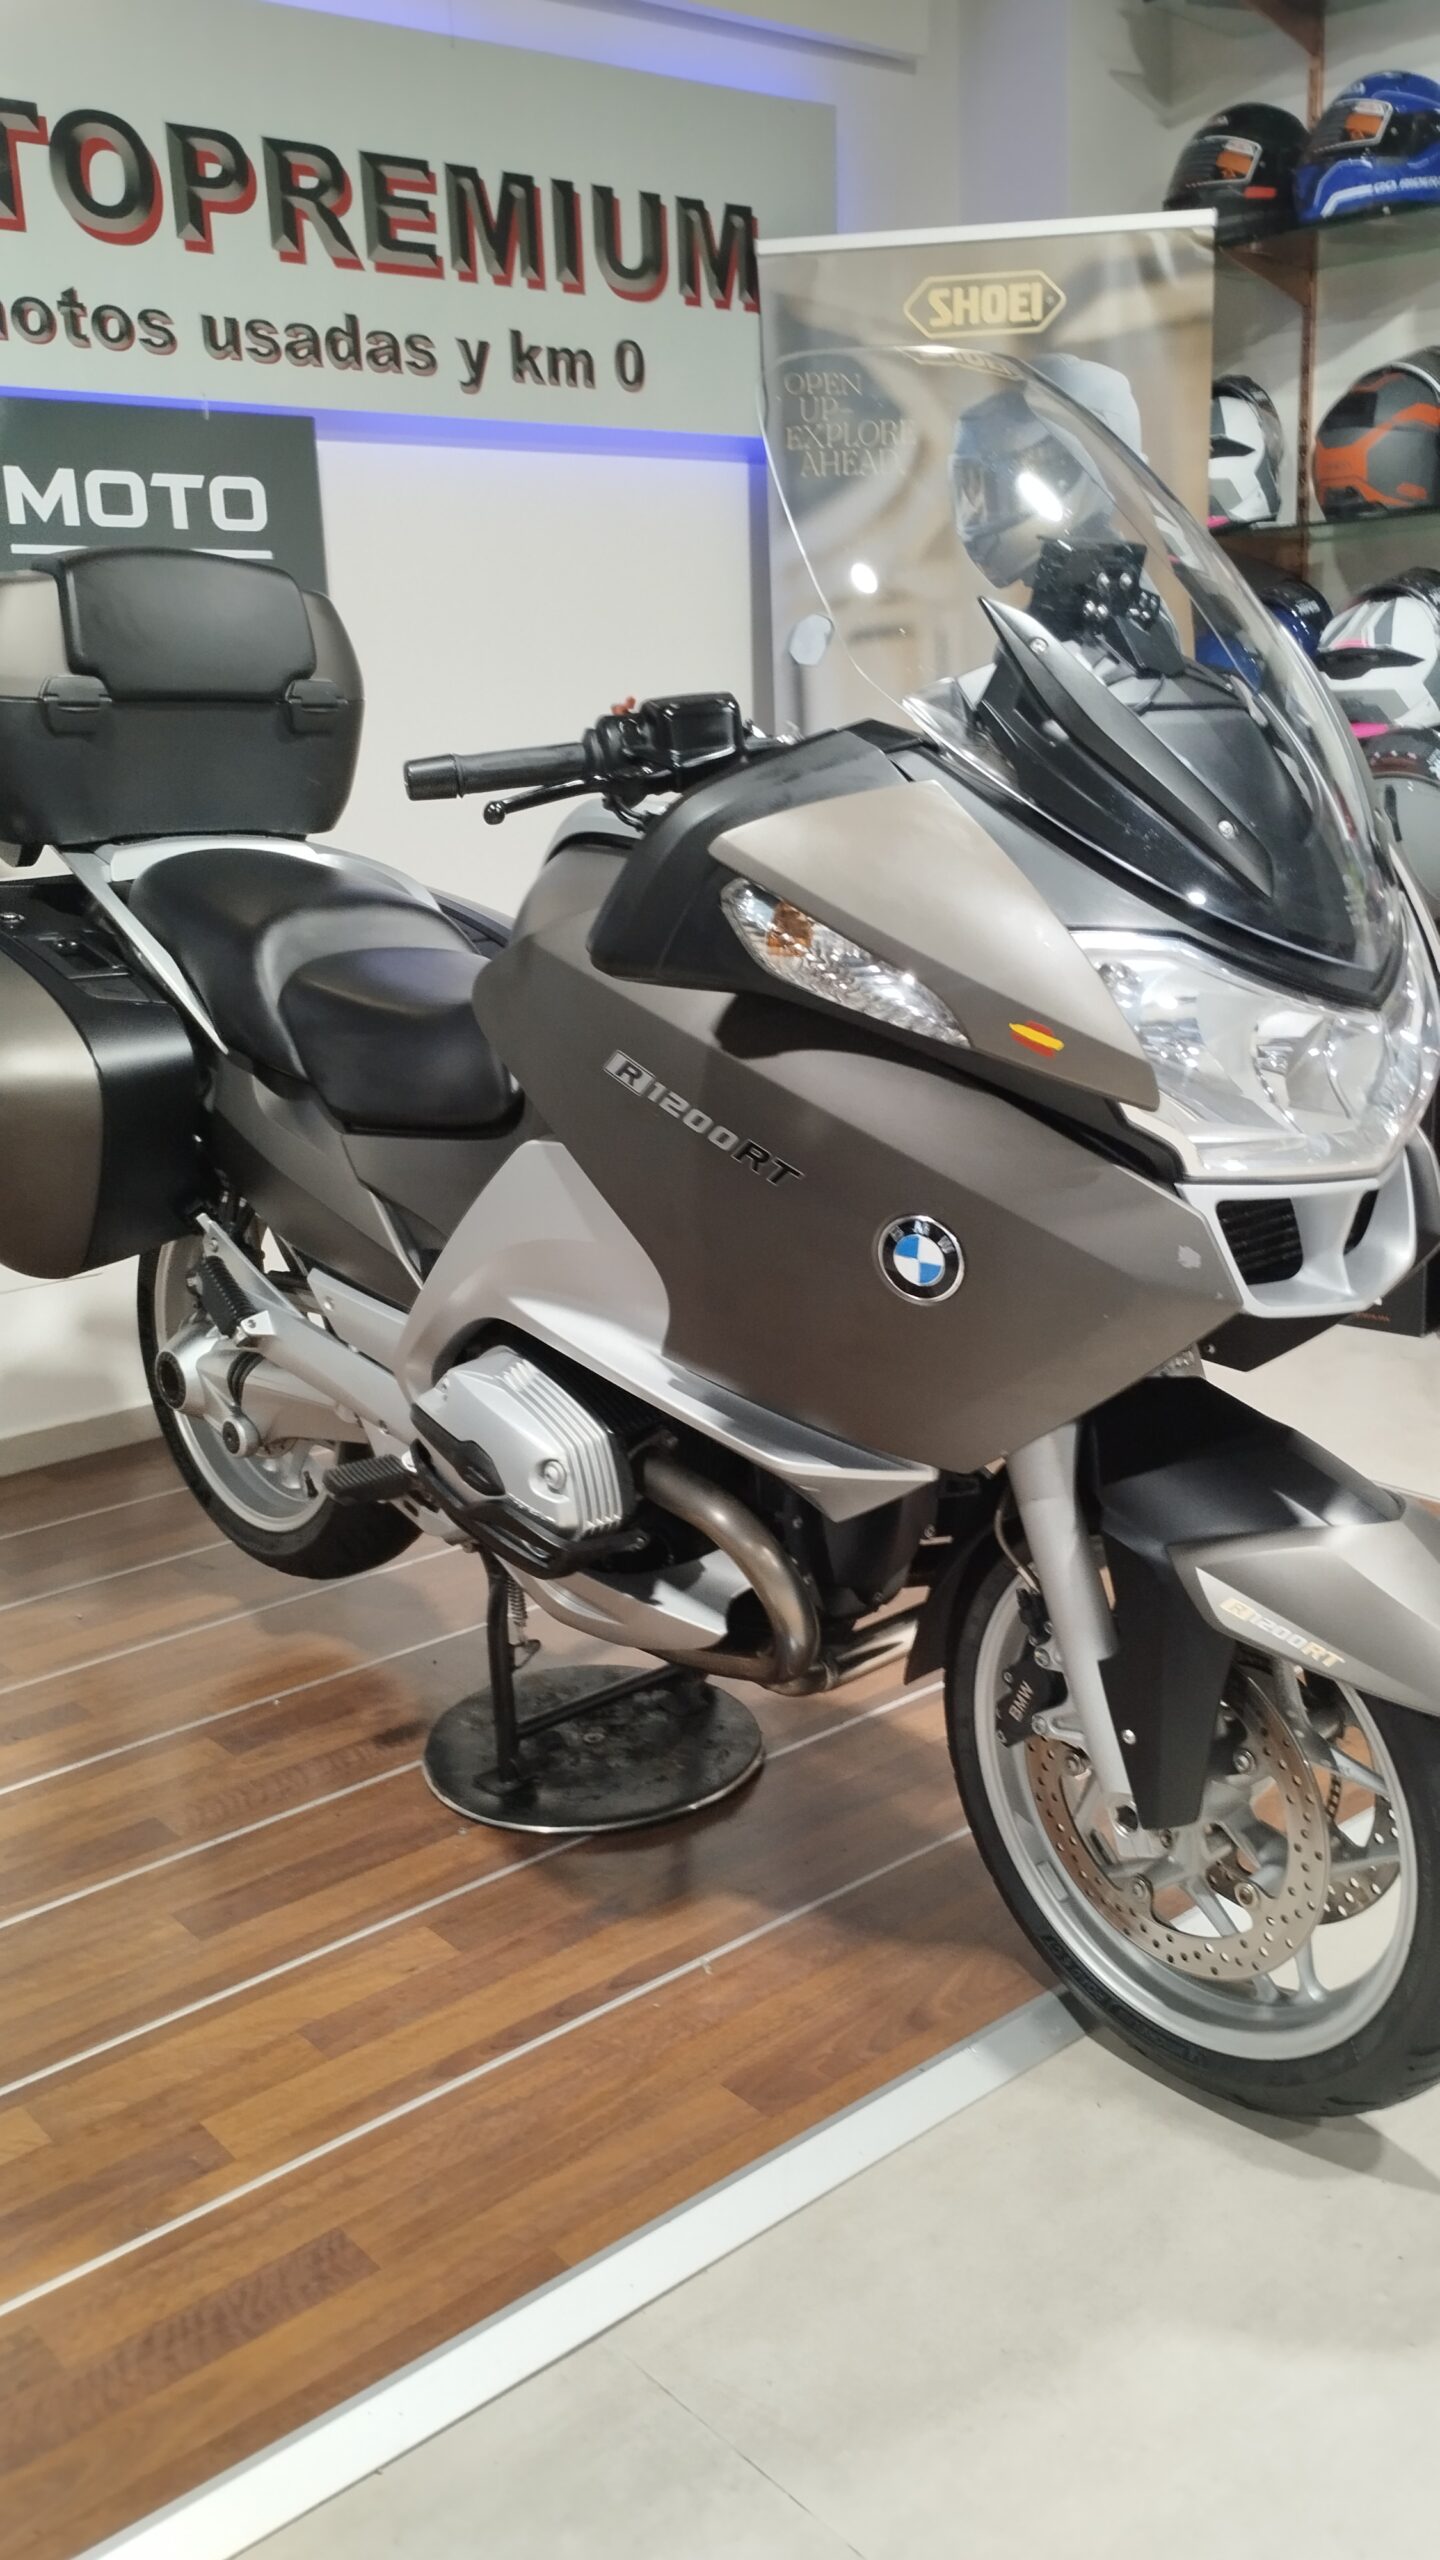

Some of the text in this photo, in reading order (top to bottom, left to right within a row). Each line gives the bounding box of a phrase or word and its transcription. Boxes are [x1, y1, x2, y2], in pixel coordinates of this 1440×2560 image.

[928, 282, 1044, 327] SHOEI
[0, 286, 178, 356] otos
[201, 314, 438, 378] usadas
[457, 336, 491, 394] y
[509, 329, 596, 389] km
[783, 371, 863, 396] OPEN
[785, 419, 917, 451] EXPLORE
[800, 448, 907, 479] AHEAD
[3, 465, 269, 532] MOTO
[889, 1219, 956, 1254] BMW
[1008, 1680, 1035, 1722] BMW
